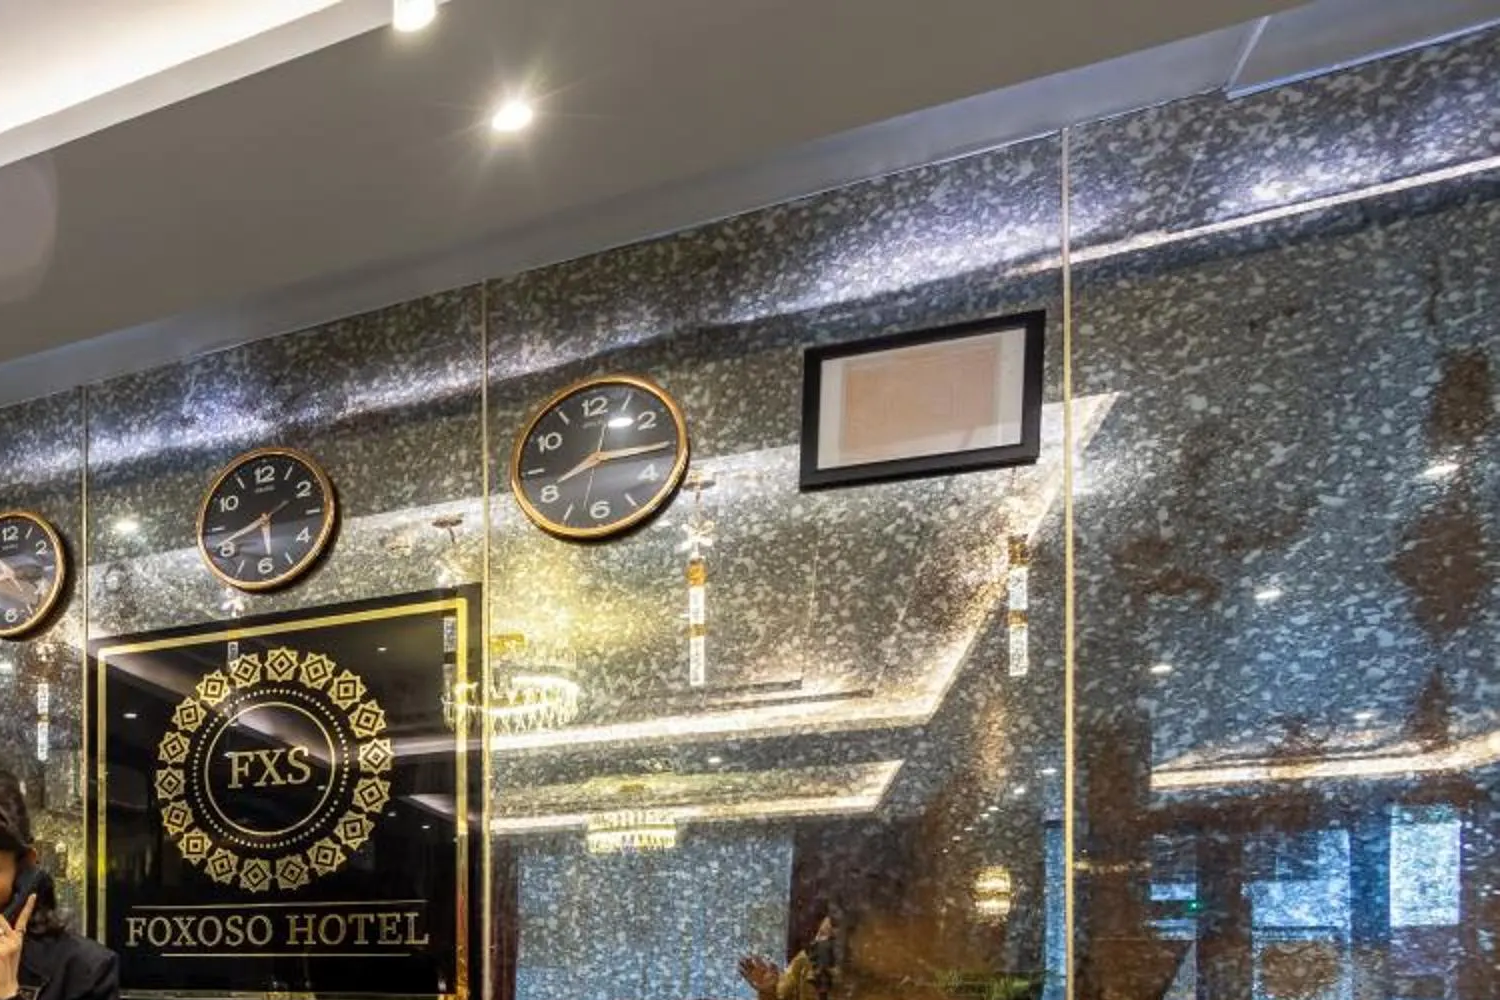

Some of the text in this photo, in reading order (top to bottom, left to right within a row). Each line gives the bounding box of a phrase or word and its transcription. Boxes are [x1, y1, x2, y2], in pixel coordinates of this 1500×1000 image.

[581, 396, 609, 417] 12
[637, 411, 657, 431] 2
[537, 431, 563, 453] 10
[253, 465, 275, 483] 12
[637, 464, 659, 482] 4
[296, 481, 311, 497] 2
[540, 484, 560, 504] 8
[219, 495, 239, 513] 10
[590, 501, 611, 519] 6
[1, 526, 19, 541] 12
[296, 527, 311, 543] 4
[35, 540, 48, 555] 2
[219, 540, 236, 557] 8
[257, 557, 274, 574] 6
[5, 609, 18, 623] 6
[224, 746, 311, 789] FXS
[125, 912, 429, 948] FOXOSO HOTEL
